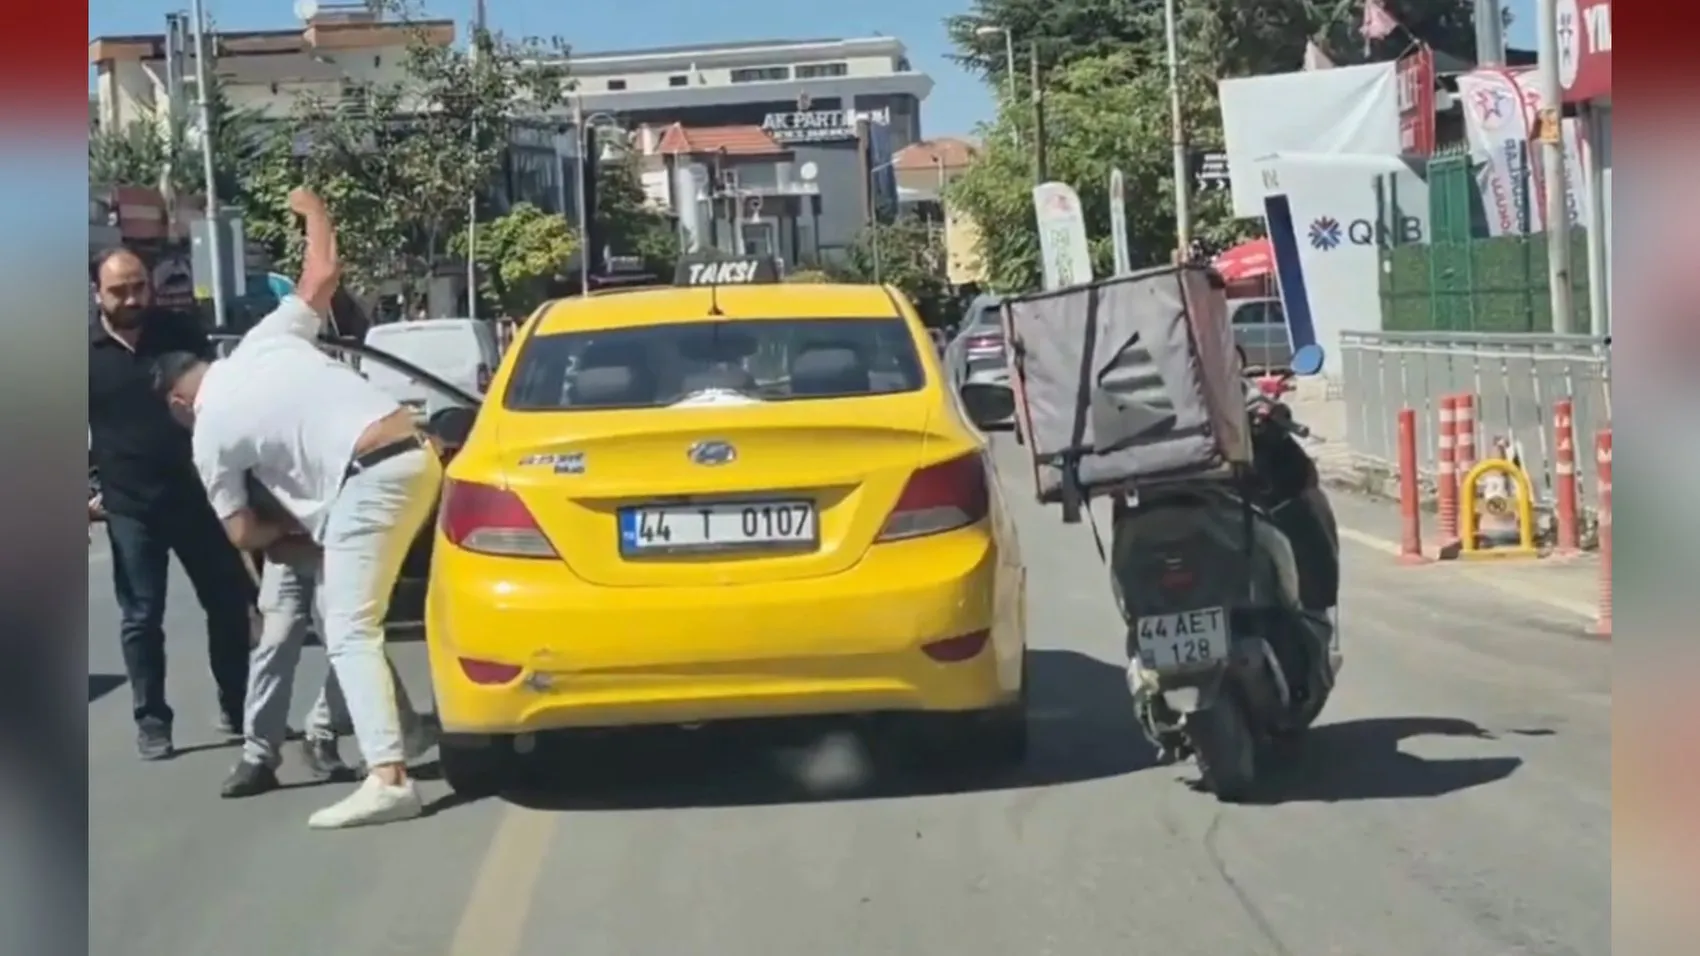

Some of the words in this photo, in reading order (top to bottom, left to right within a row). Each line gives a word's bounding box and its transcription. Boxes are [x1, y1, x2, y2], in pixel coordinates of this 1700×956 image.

[762, 111, 793, 129] AK
[1349, 216, 1422, 246] QNB
[640, 510, 671, 542] 44
[698, 508, 713, 540] T
[742, 505, 809, 537] 0107
[1141, 619, 1167, 639] 44
[1175, 610, 1221, 636] AET
[1171, 638, 1210, 663] 128
